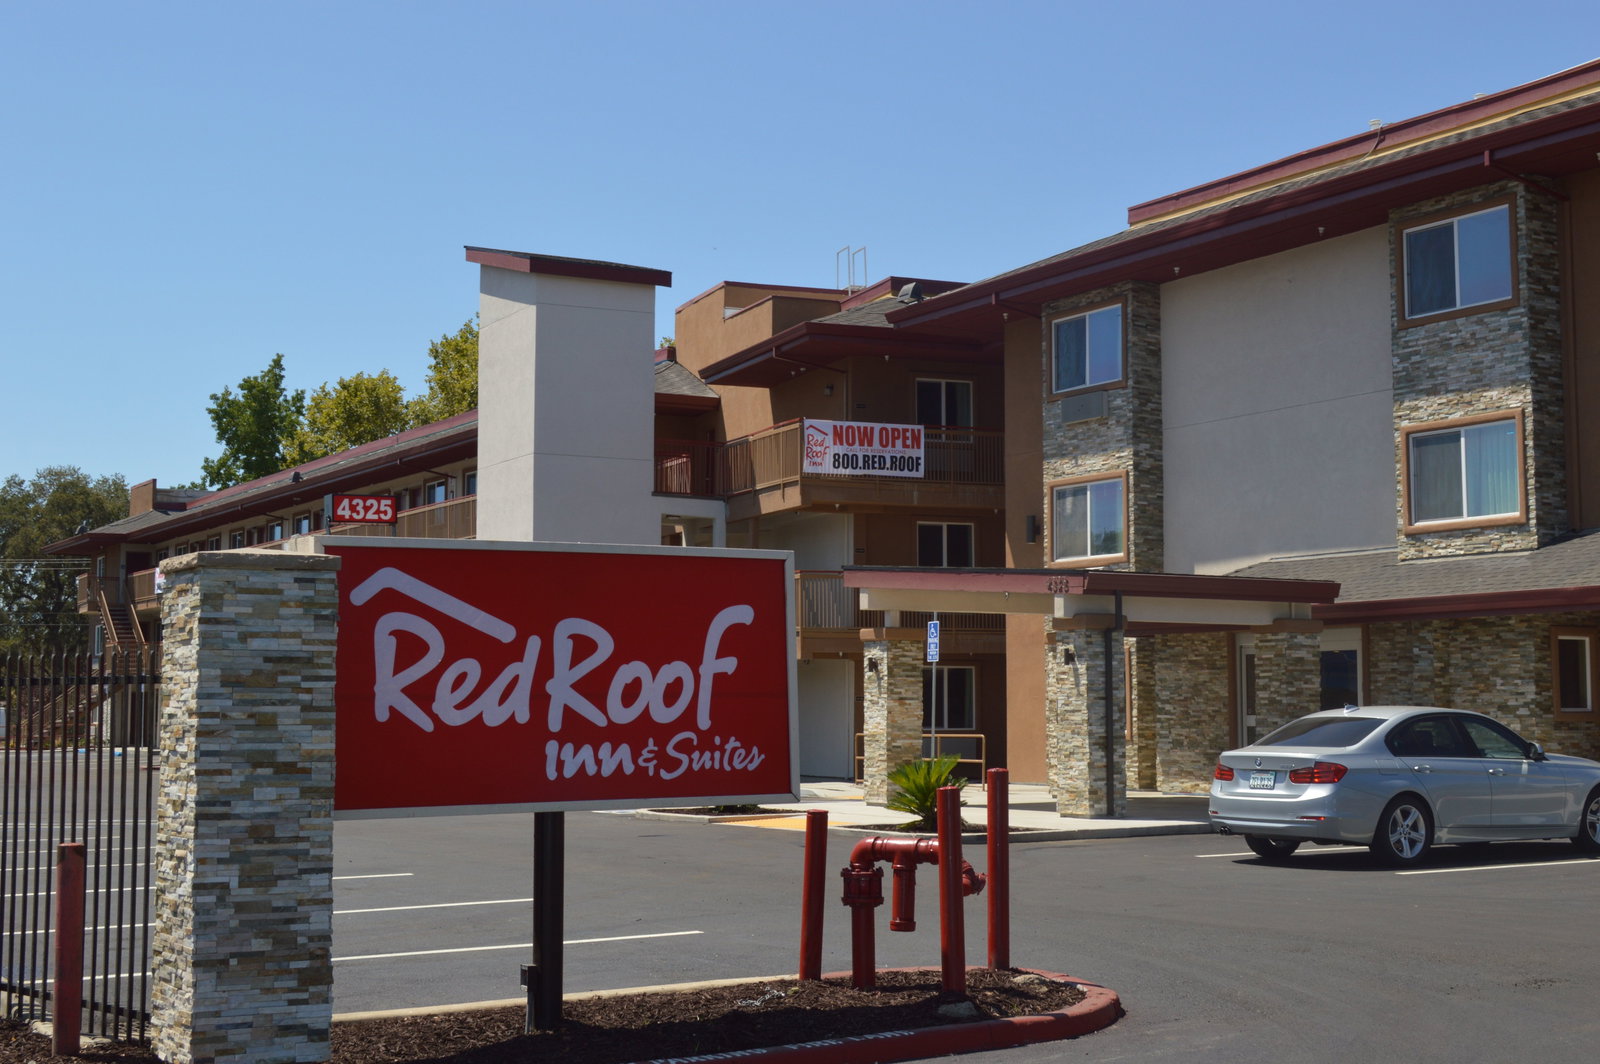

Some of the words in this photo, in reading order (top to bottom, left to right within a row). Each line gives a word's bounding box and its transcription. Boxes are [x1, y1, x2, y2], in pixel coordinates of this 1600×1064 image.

[807, 434, 826, 447] Red
[833, 425, 874, 447] NOW
[879, 427, 921, 449] OPEN
[806, 446, 830, 461] Roof
[833, 453, 921, 472] 800.RED.ROOF
[337, 498, 393, 520] 4325
[374, 611, 541, 733] Red
[545, 604, 755, 733] Roof
[544, 740, 635, 781] Inn
[638, 738, 657, 776] &
[659, 731, 765, 781] Suites
